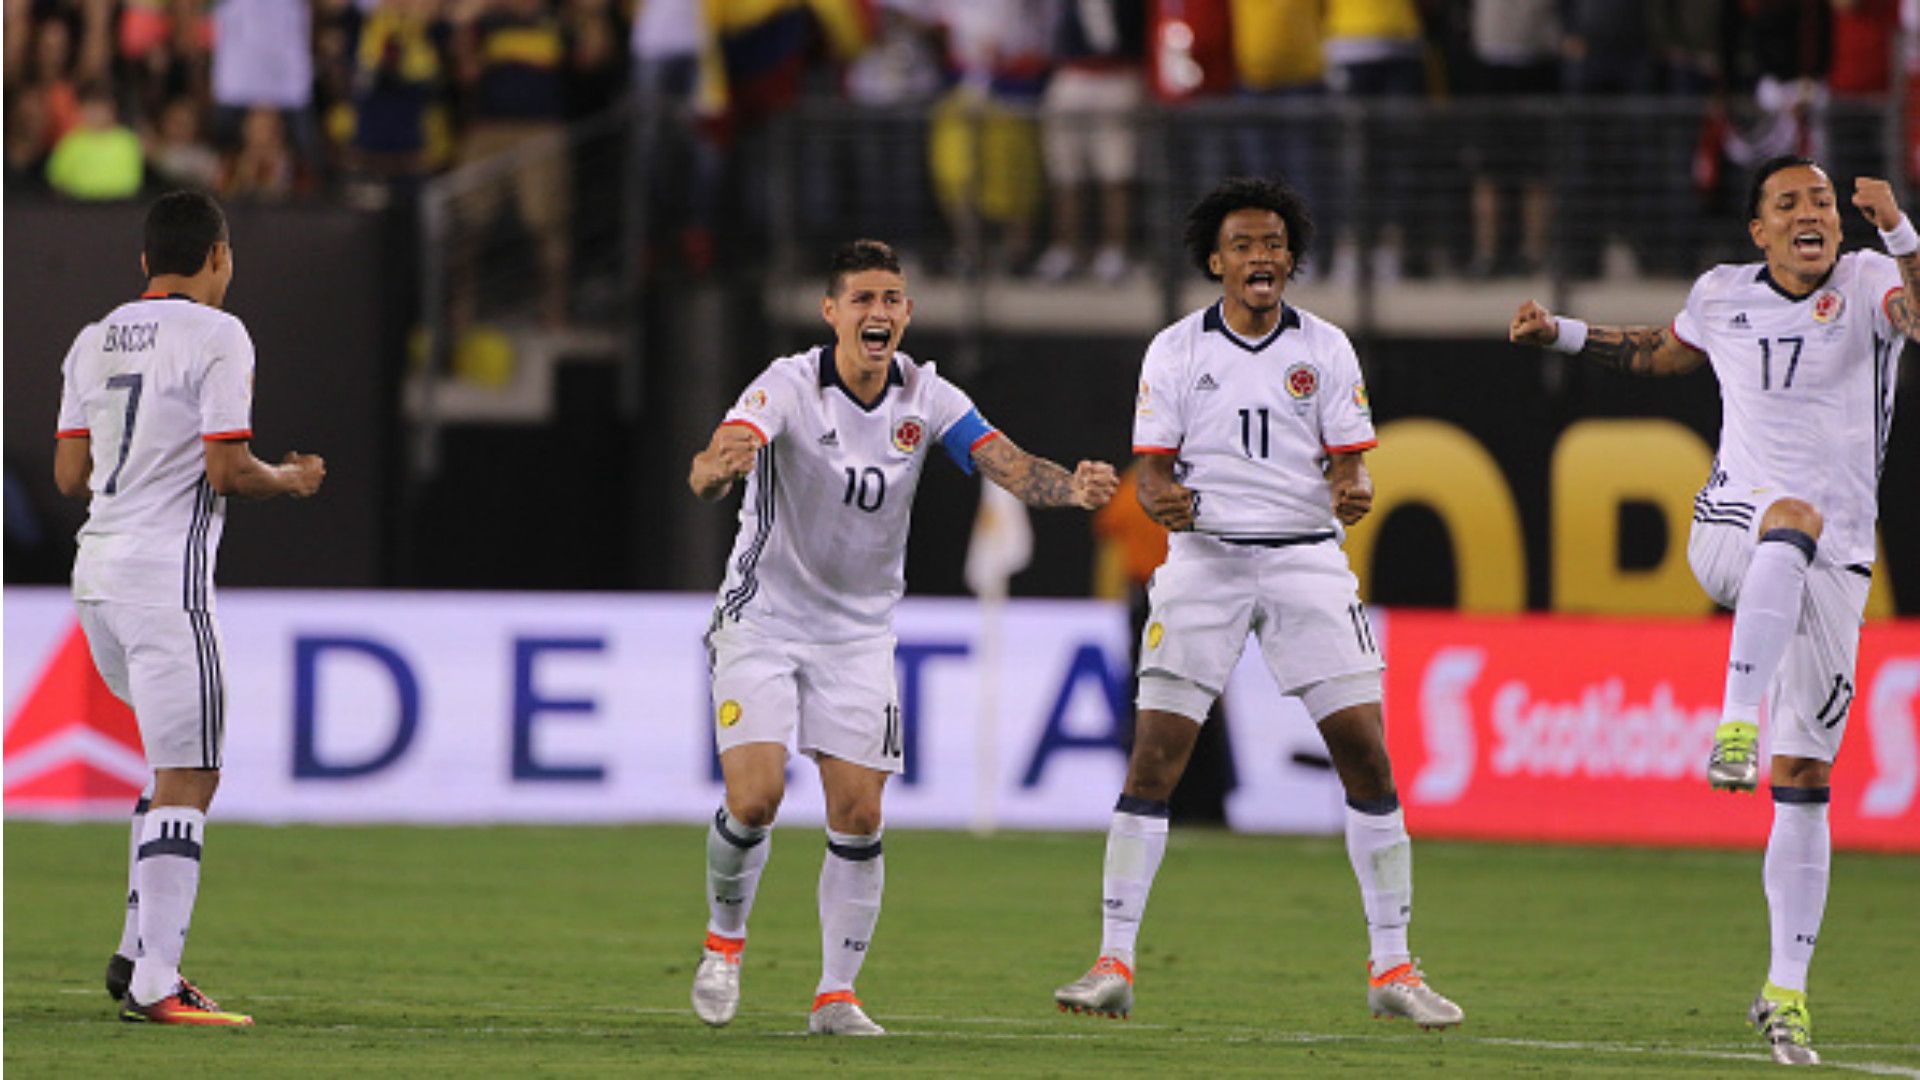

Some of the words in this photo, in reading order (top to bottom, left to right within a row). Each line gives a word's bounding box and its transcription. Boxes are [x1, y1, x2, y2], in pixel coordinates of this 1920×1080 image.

[103, 323, 159, 352] BACCA
[1758, 335, 1804, 390] 17
[105, 373, 143, 496] 7
[1238, 408, 1269, 459] 11
[841, 466, 886, 512] 10
[1348, 603, 1375, 653] 11
[1816, 673, 1853, 729] 17
